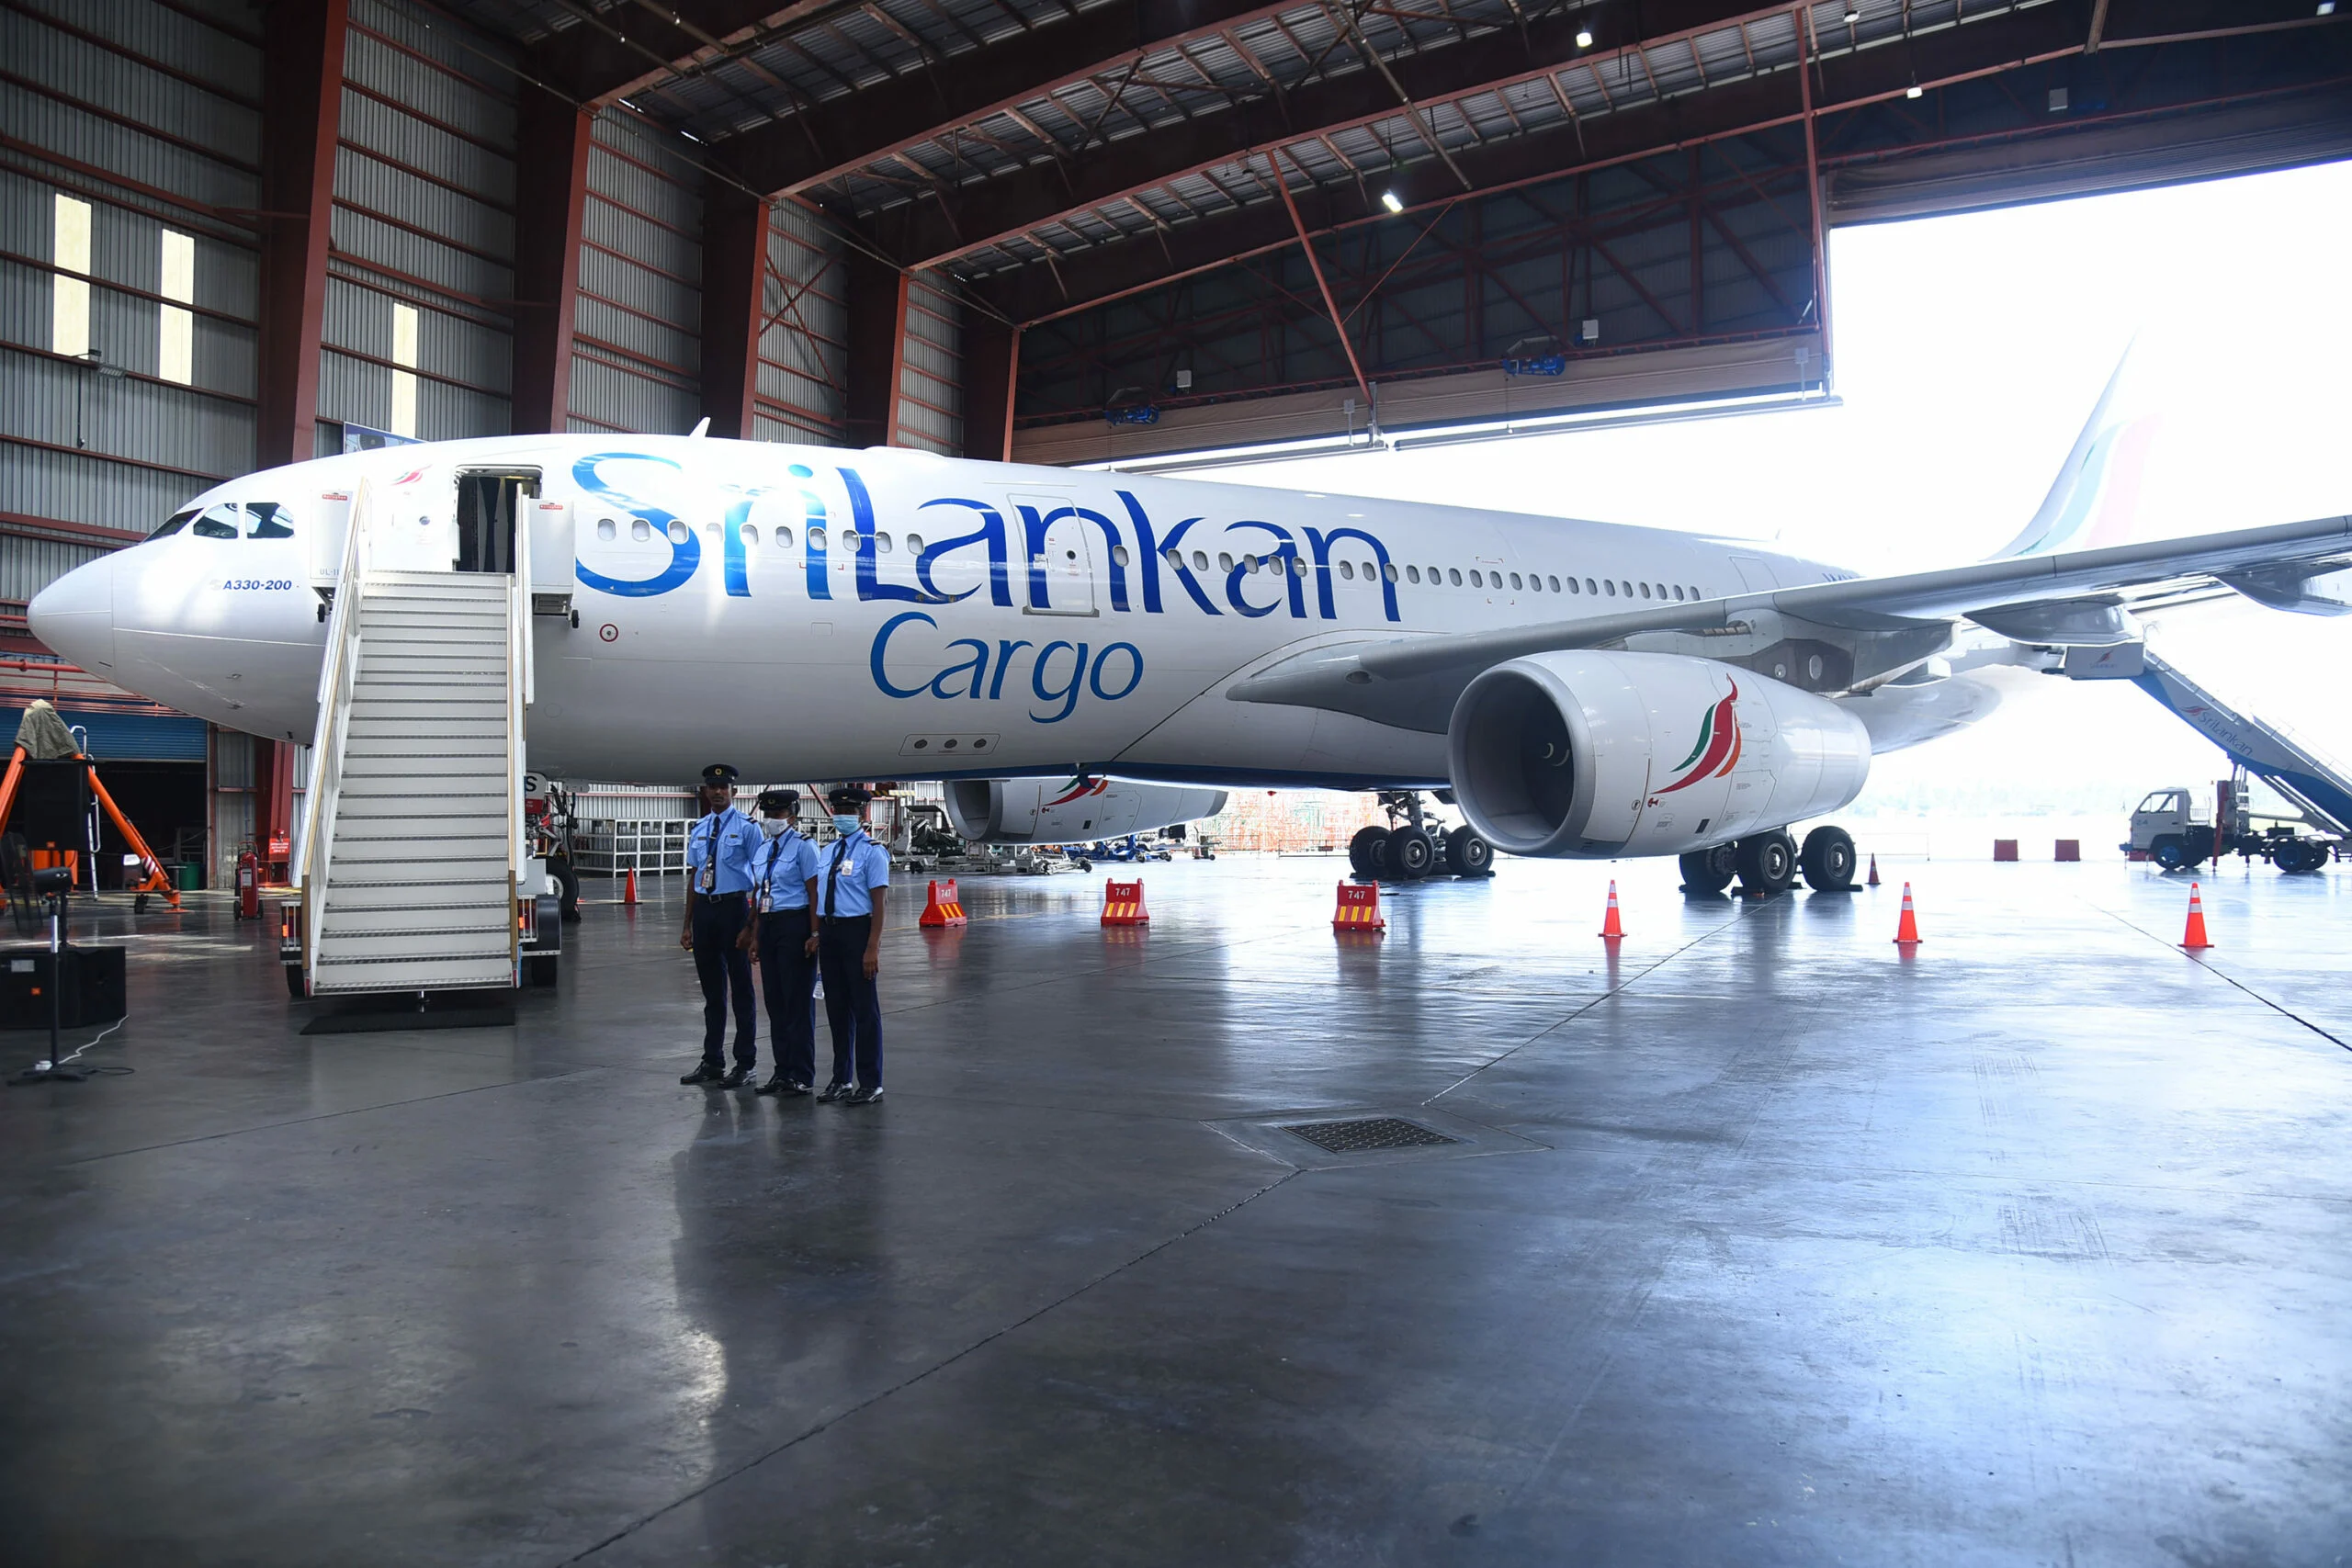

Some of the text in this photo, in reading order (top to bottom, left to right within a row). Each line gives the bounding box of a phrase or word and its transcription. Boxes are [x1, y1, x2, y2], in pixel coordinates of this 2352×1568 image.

[572, 453, 1401, 622] SriLankan
[223, 580, 292, 591] A330-200
[870, 612, 1144, 724] Cargo
[2198, 711, 2253, 756] SriLankan
[941, 888, 952, 898] 747
[1114, 887, 1131, 897] 747
[1348, 890, 1366, 900] 747
